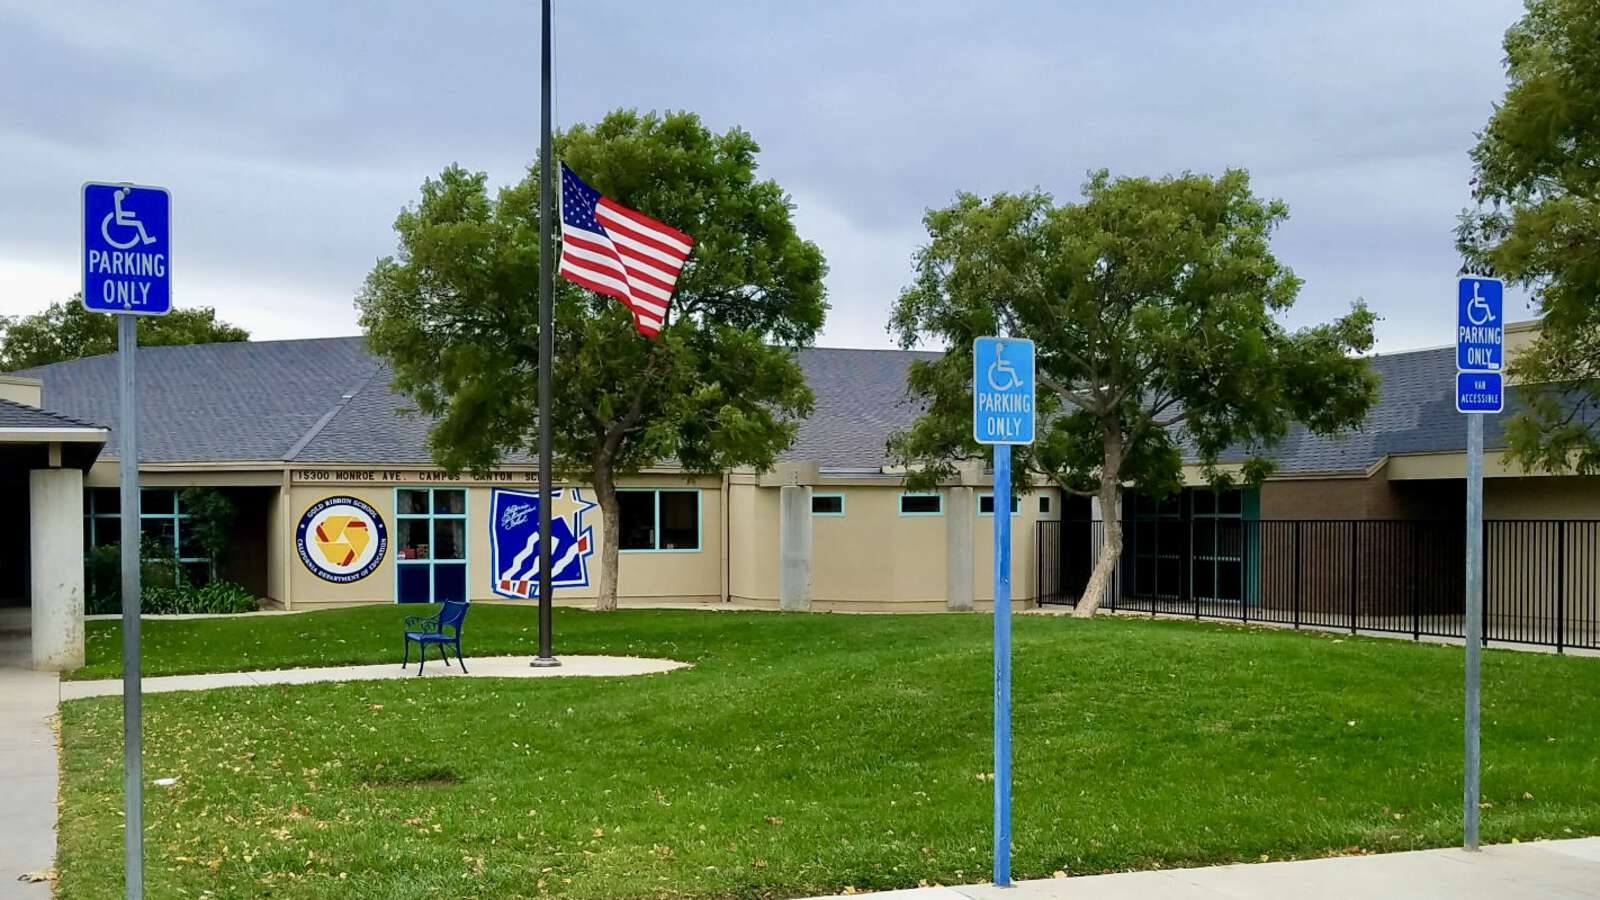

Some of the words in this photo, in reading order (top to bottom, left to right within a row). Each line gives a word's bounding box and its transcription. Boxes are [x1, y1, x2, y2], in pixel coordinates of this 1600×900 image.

[89, 249, 165, 277] PARKING
[103, 279, 152, 305] ONLY
[1459, 326, 1501, 344] PARKING
[1467, 347, 1493, 366] ONLY
[1474, 380, 1486, 390] VAN
[979, 392, 1031, 413] PARKING
[1461, 393, 1499, 404] ACCESSIBLE
[987, 416, 1022, 436] ONLY
[297, 471, 330, 481] 15300
[335, 471, 375, 481] MONROE
[306, 503, 324, 518] GOLD
[325, 498, 352, 506] RIBBON
[353, 500, 377, 519] SCHOOL
[297, 538, 317, 573] CALIFORNIA
[318, 569, 360, 582] DEPARTMENT
[368, 538, 387, 572] EDUCATION
